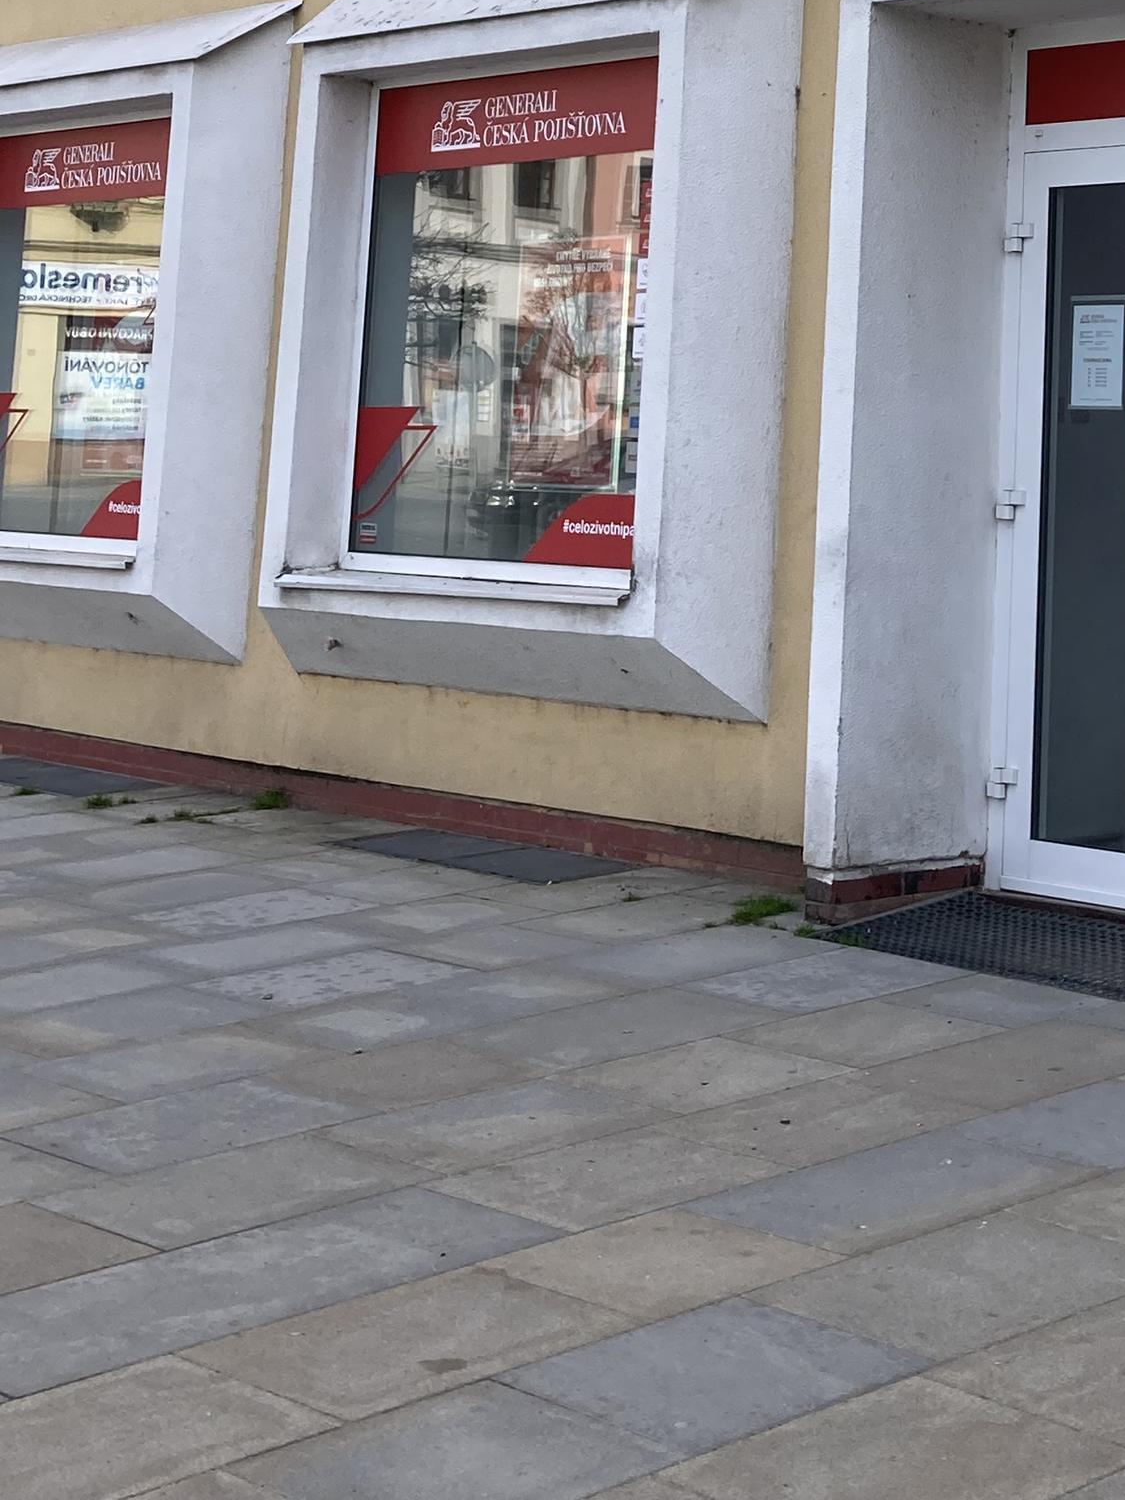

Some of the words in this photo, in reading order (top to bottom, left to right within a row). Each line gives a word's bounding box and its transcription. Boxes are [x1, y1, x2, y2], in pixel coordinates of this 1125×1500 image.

[485, 89, 557, 120] GENERALI
[484, 117, 529, 147] ČESKÁ
[533, 111, 626, 142] POJIŠŤOVNA
[63, 142, 115, 165] GENERALI
[61, 165, 94, 189] ČESKÁ
[97, 161, 161, 186] POJIŠŤOVNA
